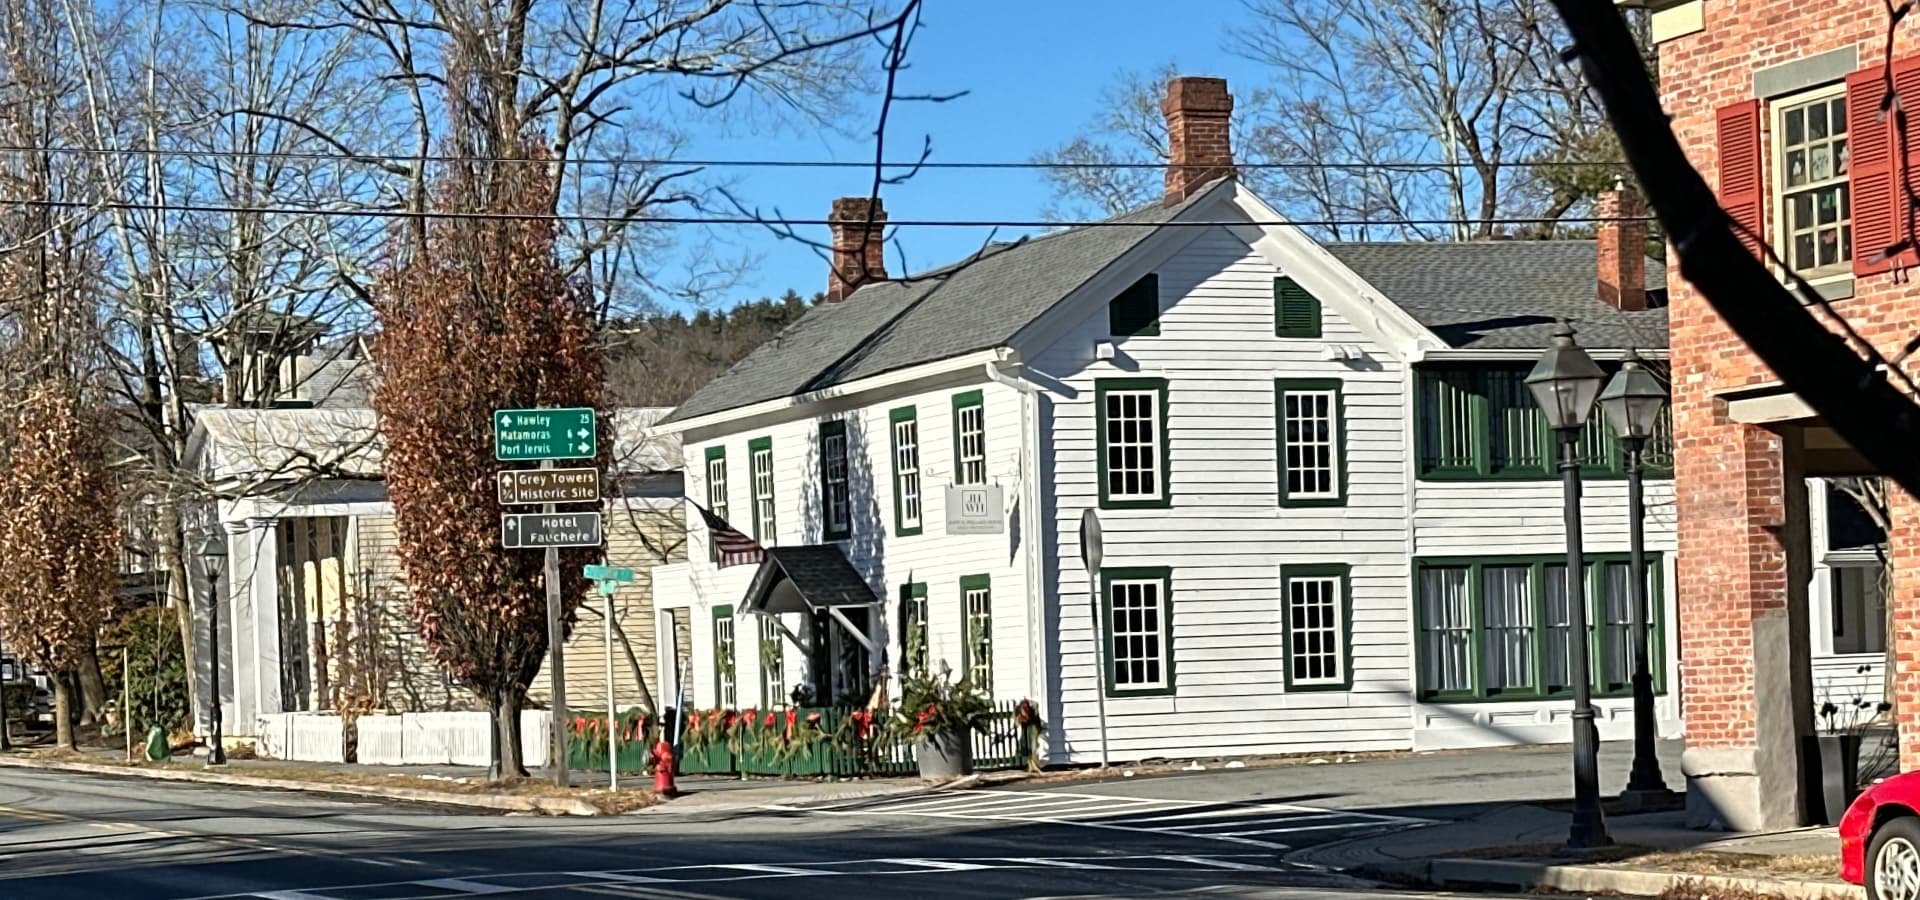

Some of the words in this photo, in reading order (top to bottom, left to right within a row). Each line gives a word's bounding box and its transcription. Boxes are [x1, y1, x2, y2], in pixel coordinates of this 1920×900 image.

[517, 414, 551, 428] Hawley
[580, 413, 590, 424] 25
[500, 429, 551, 441] Matamoras
[567, 428, 573, 439] 6
[501, 444, 520, 455] Port
[524, 443, 551, 455] Jervis
[568, 442, 574, 453] 7
[519, 474, 546, 487] Grey
[551, 473, 594, 484] Towers
[520, 486, 567, 500] Historic
[571, 486, 594, 498] Site
[542, 515, 577, 528] Hotel
